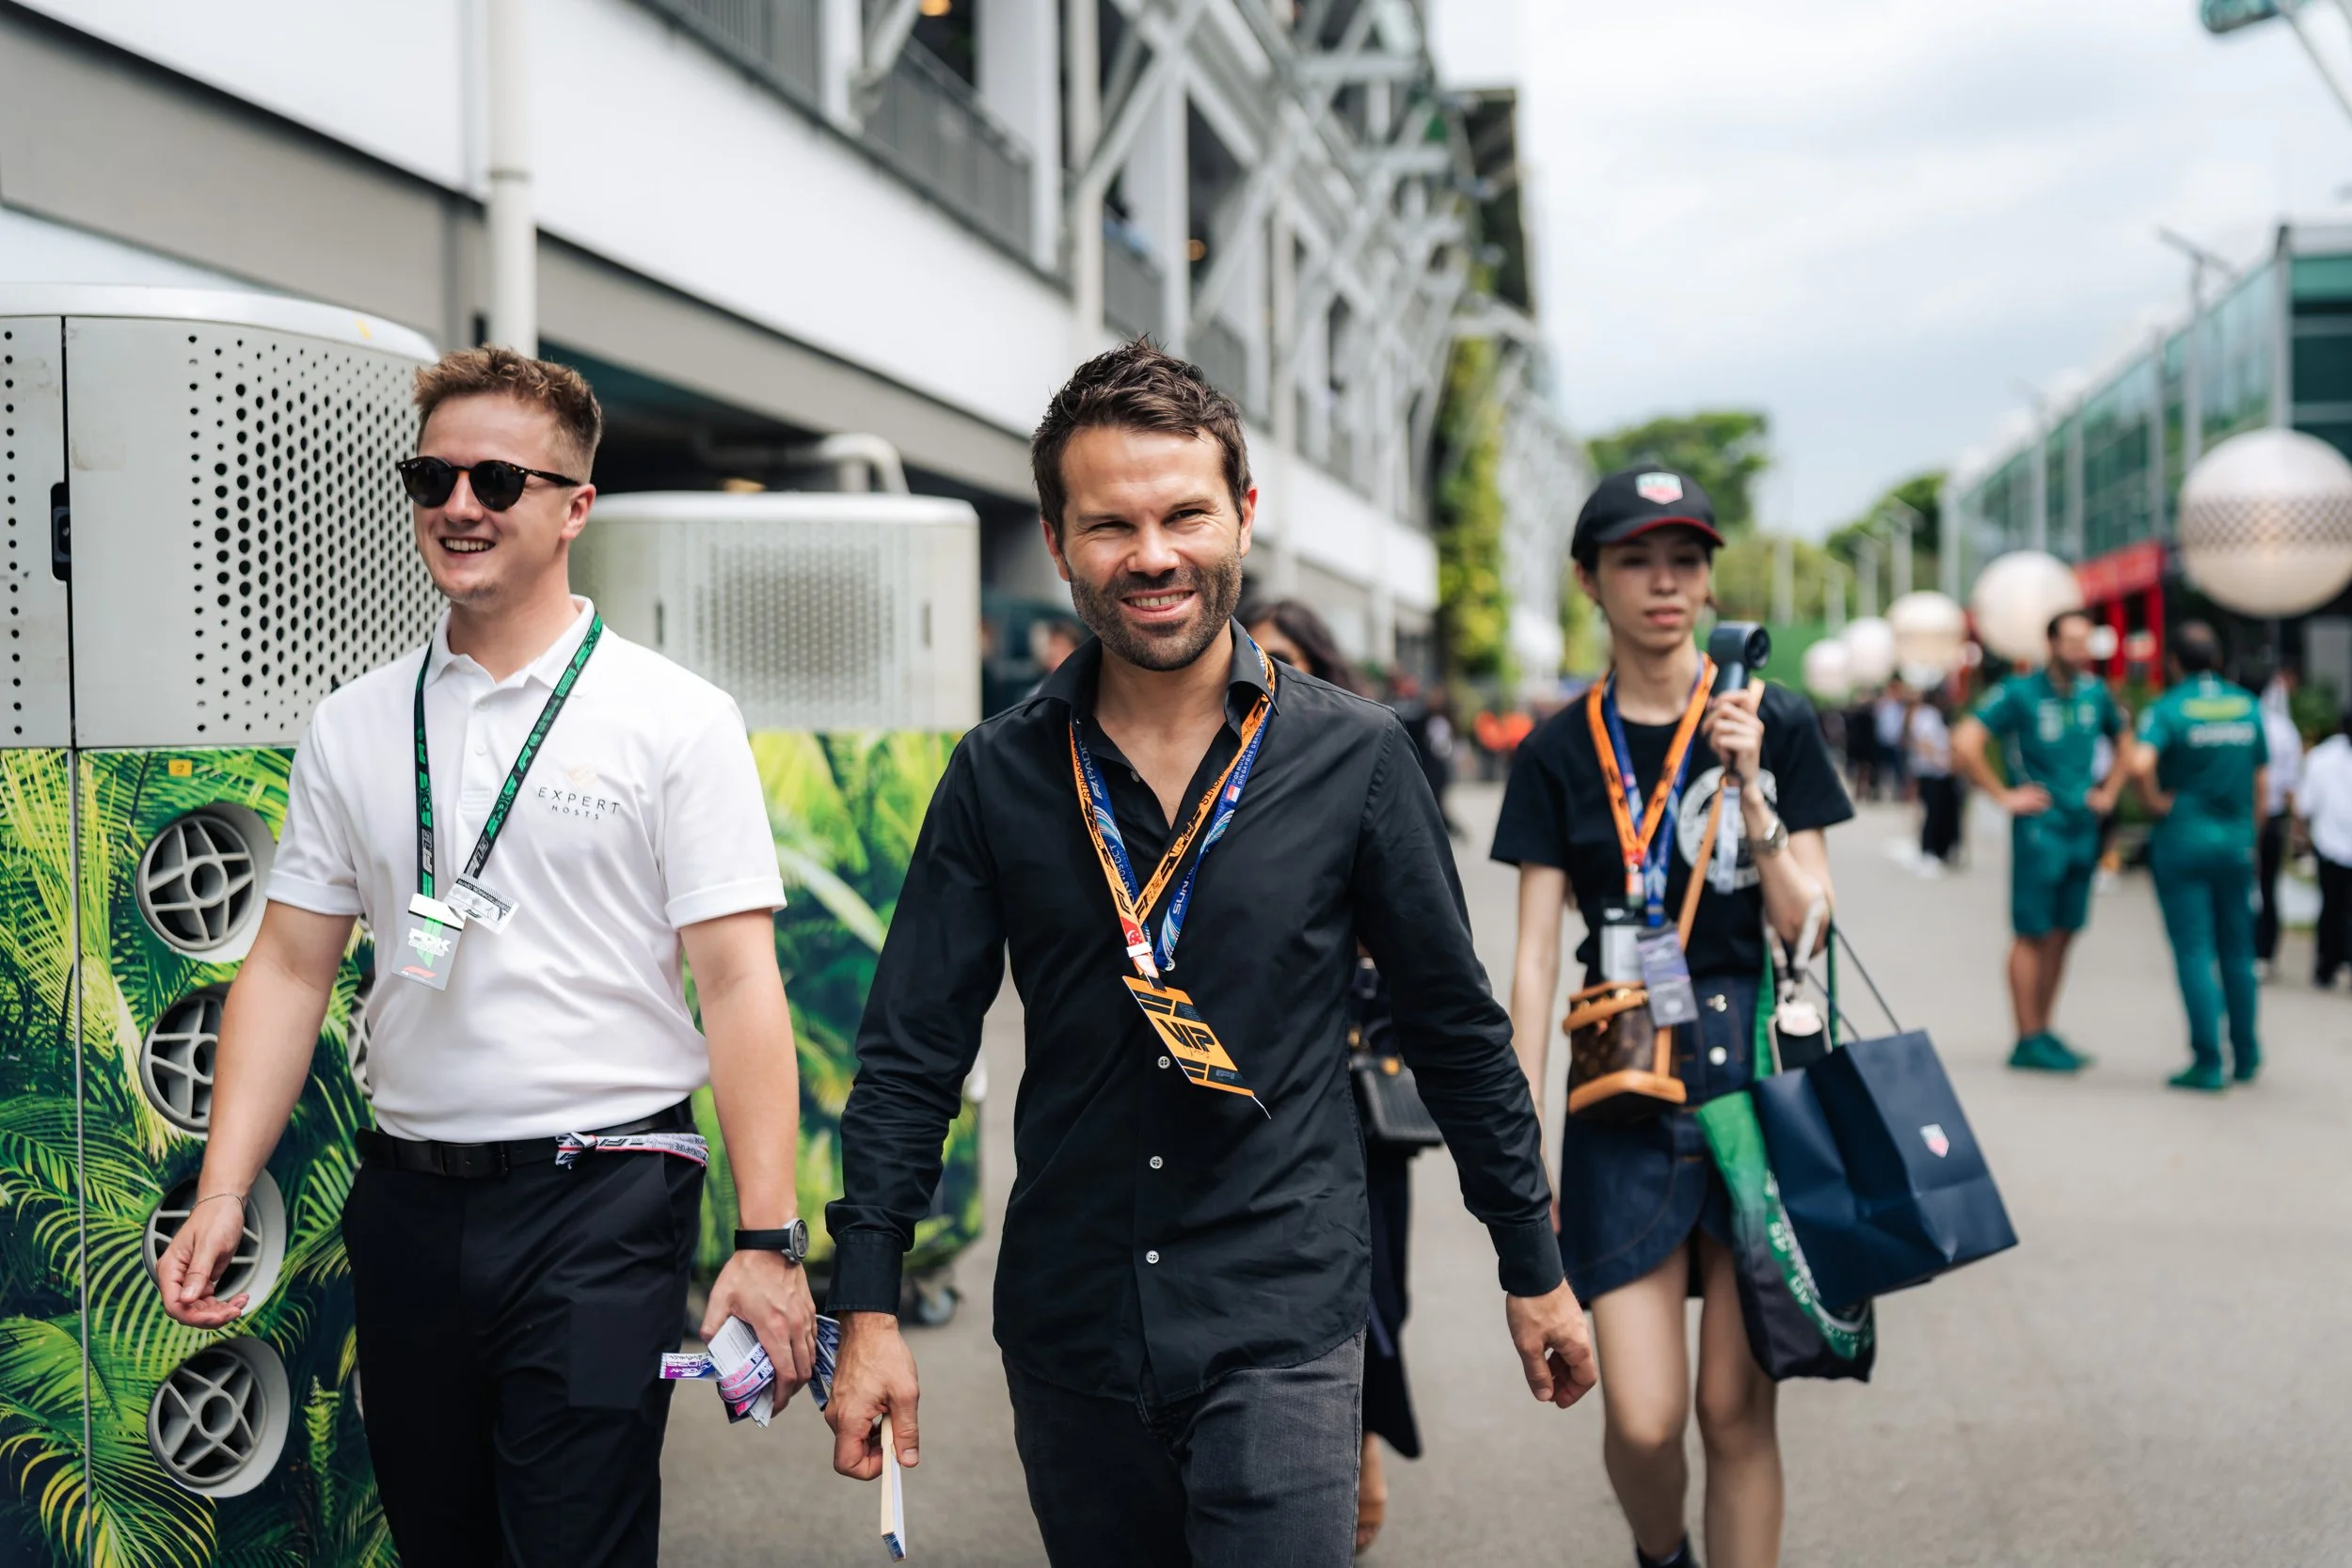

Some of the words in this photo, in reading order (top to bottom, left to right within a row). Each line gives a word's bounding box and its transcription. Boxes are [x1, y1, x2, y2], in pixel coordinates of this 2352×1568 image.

[1237, 750, 1255, 785] SINGAPORE
[1250, 727, 1263, 749] GRAND
[538, 786, 621, 814] EXPERT
[551, 804, 600, 820] HOSTS
[1109, 844, 1122, 864] OCT
[1168, 836, 1185, 858] VIP
[1172, 880, 1189, 915] SUN
[1155, 1017, 1216, 1053] VIP
